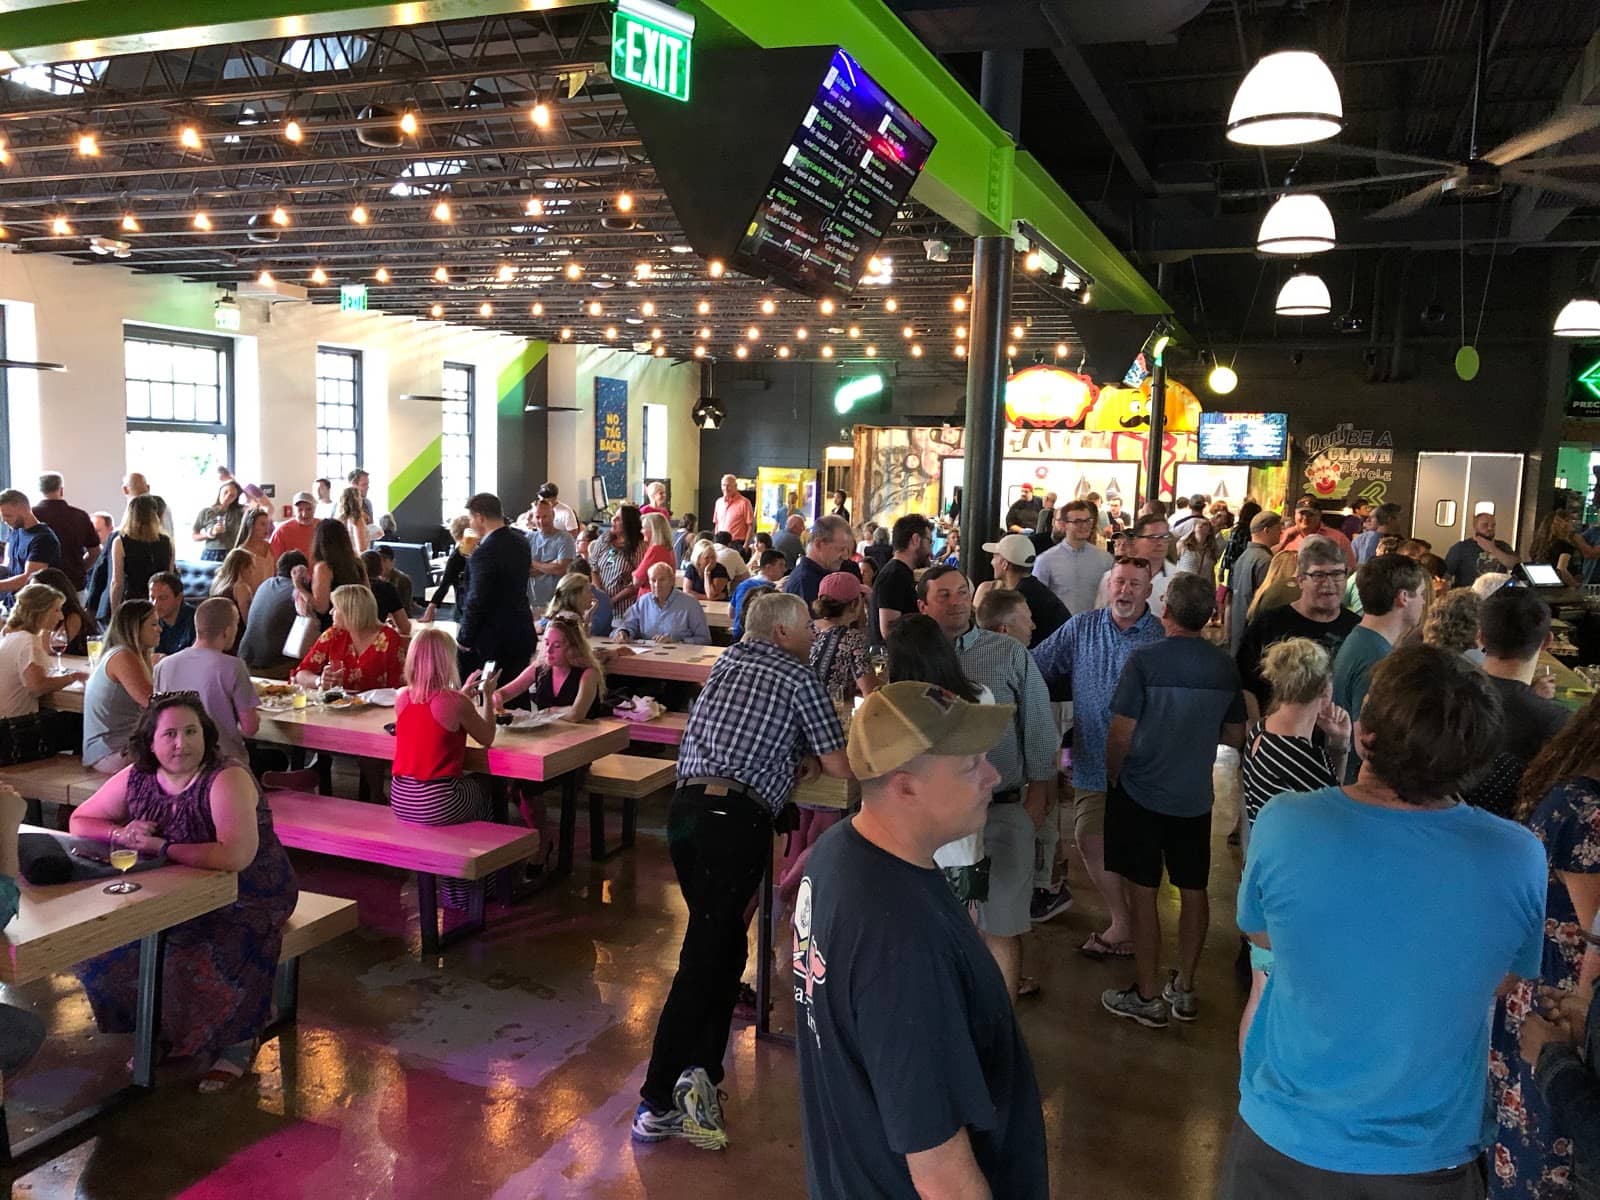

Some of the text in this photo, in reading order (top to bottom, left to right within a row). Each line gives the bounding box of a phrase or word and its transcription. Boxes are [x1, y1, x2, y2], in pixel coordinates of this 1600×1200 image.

[625, 20, 683, 95] EXIT
[606, 412, 620, 425] NO
[605, 425, 622, 439] TAG
[1346, 430, 1374, 446] BE
[1376, 430, 1393, 446] A
[599, 438, 626, 453] BACKS
[1328, 447, 1393, 464] CLOWN
